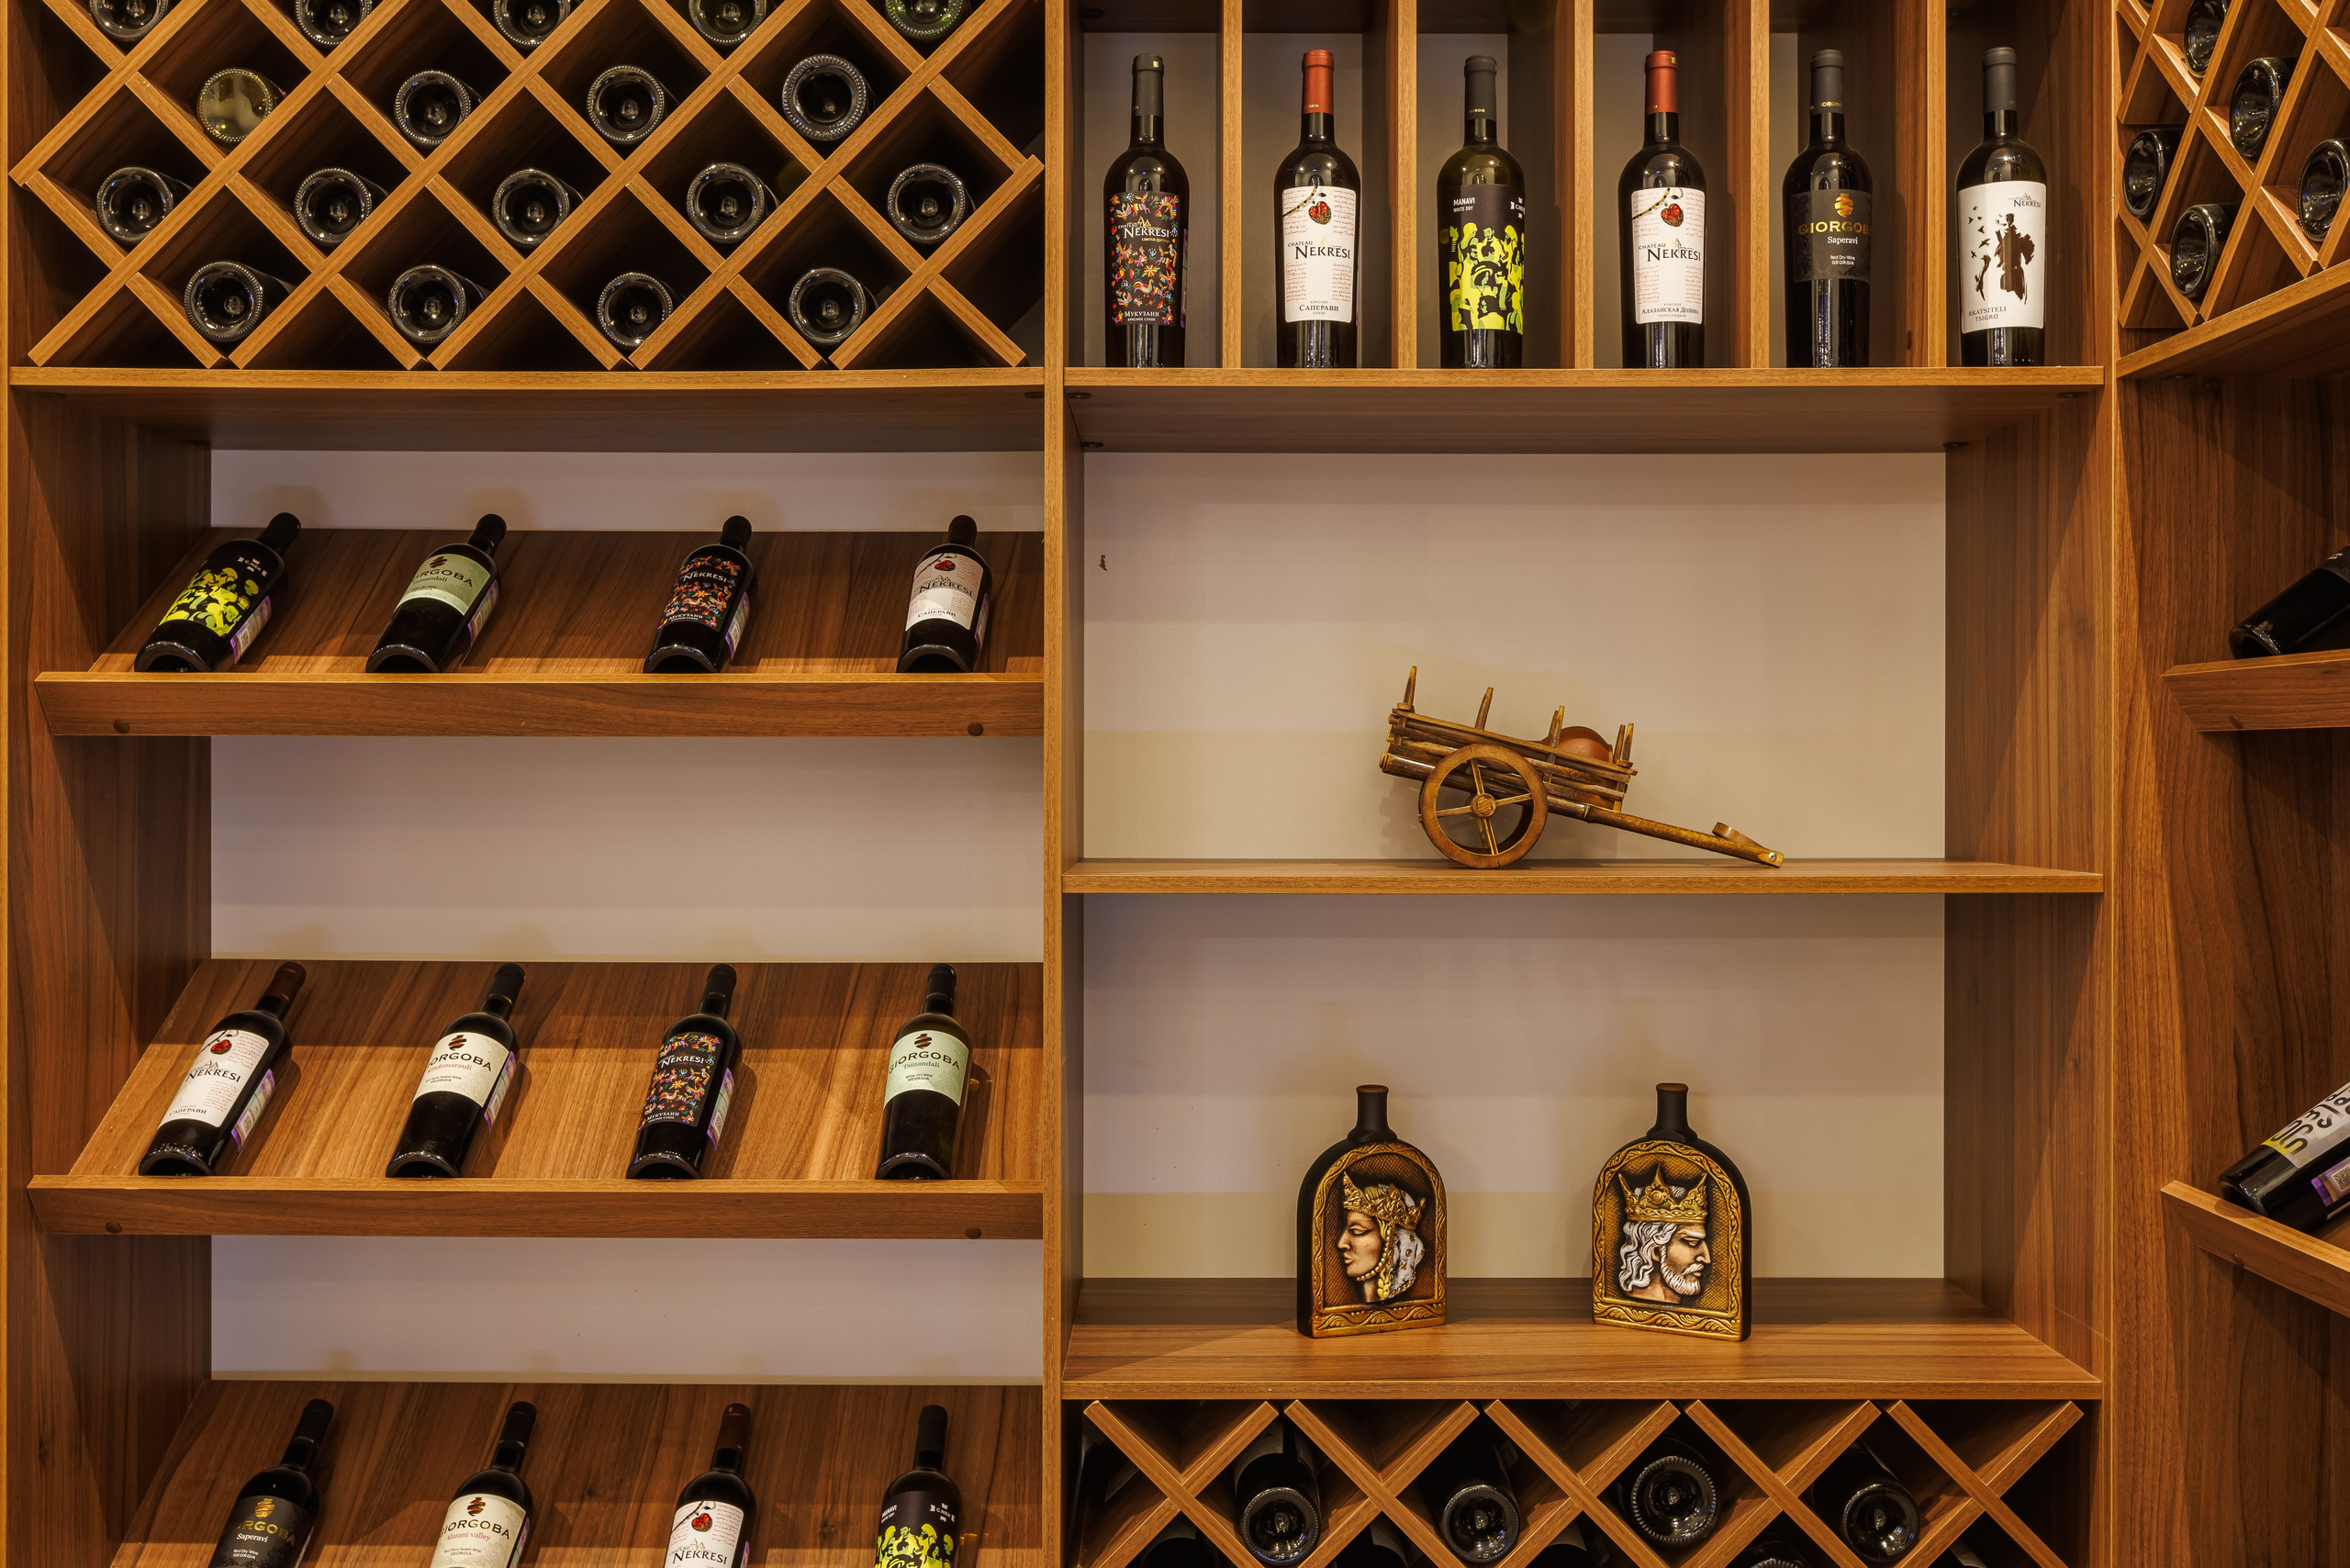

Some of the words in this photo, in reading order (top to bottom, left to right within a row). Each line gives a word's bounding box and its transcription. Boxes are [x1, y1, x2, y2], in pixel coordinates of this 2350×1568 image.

[1453, 196, 1475, 207] MANAVI
[2013, 199, 2042, 208] NEKRESI
[1124, 227, 1169, 239] NEKRESI
[1798, 220, 1872, 236] GIORGOB
[1638, 242, 1666, 251] CHATEAU
[1827, 236, 1859, 246] Saperavi
[1295, 245, 1350, 260] NEKRESI
[1647, 247, 1701, 262] NEKRESI
[1299, 304, 1339, 312] САПЕРАВИ
[1968, 306, 2007, 318] RKATSITELI
[1975, 313, 1999, 322] TSIGRO
[682, 572, 727, 582] NEKRESI
[919, 580, 973, 597] NEKRESI
[430, 1052, 492, 1072] ORGOBA
[661, 1055, 705, 1070] NEKRESI
[889, 1050, 960, 1074] GIORGOBA
[902, 1060, 940, 1070] Tsinandali
[185, 1068, 241, 1083] NEKRESI
[236, 1532, 269, 1543] Saperavi
[470, 1531, 492, 1542] valley
[672, 1550, 728, 1565] NEKRESI
